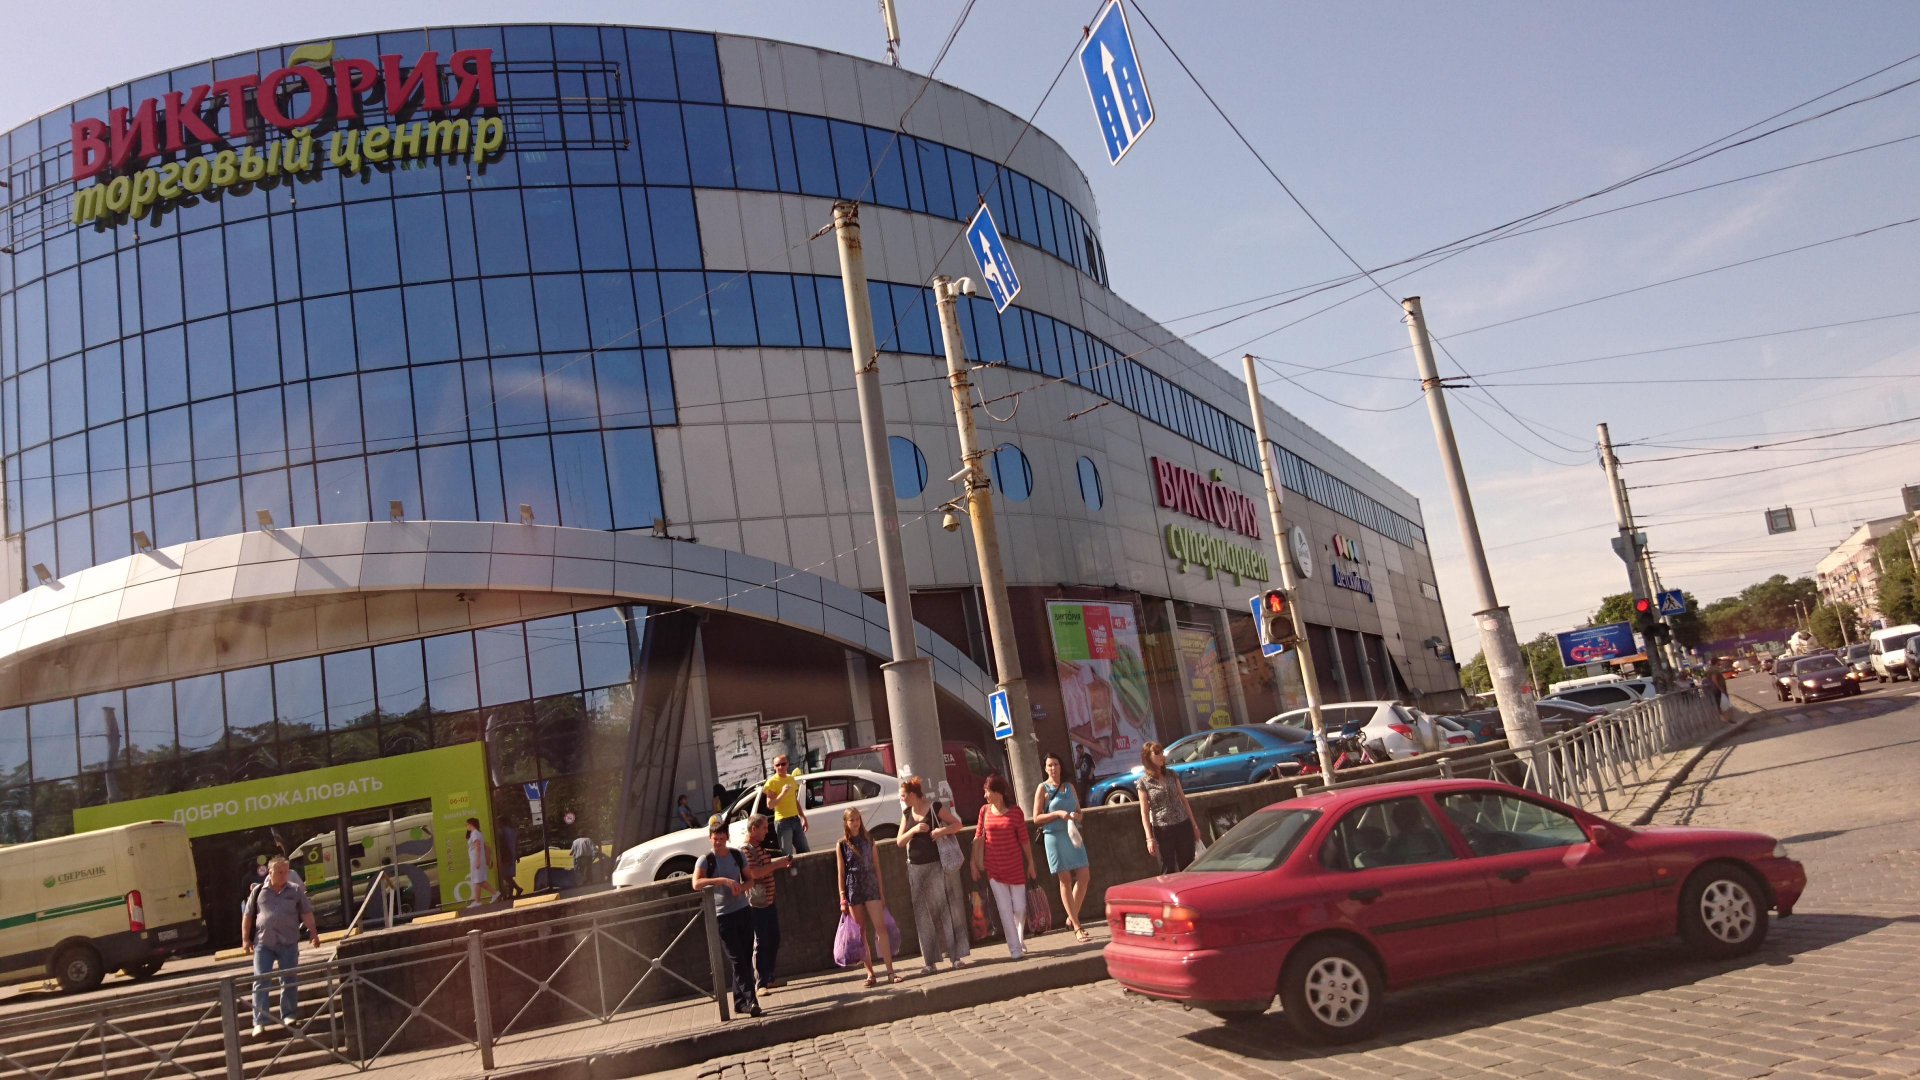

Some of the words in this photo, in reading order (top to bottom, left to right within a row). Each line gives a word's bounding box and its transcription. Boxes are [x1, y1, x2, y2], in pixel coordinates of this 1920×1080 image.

[71, 48, 498, 180] ВИКТОРИЯ
[72, 127, 313, 224] торговый
[330, 115, 504, 174] центр
[1152, 457, 1262, 540] ВИКТОРИЯ
[1167, 523, 1269, 586] супермаркет
[173, 799, 239, 825] ДОБРО
[245, 776, 384, 813] ПОЖАЛОВАТЬ
[57, 865, 107, 882] СБЕРБАНК
